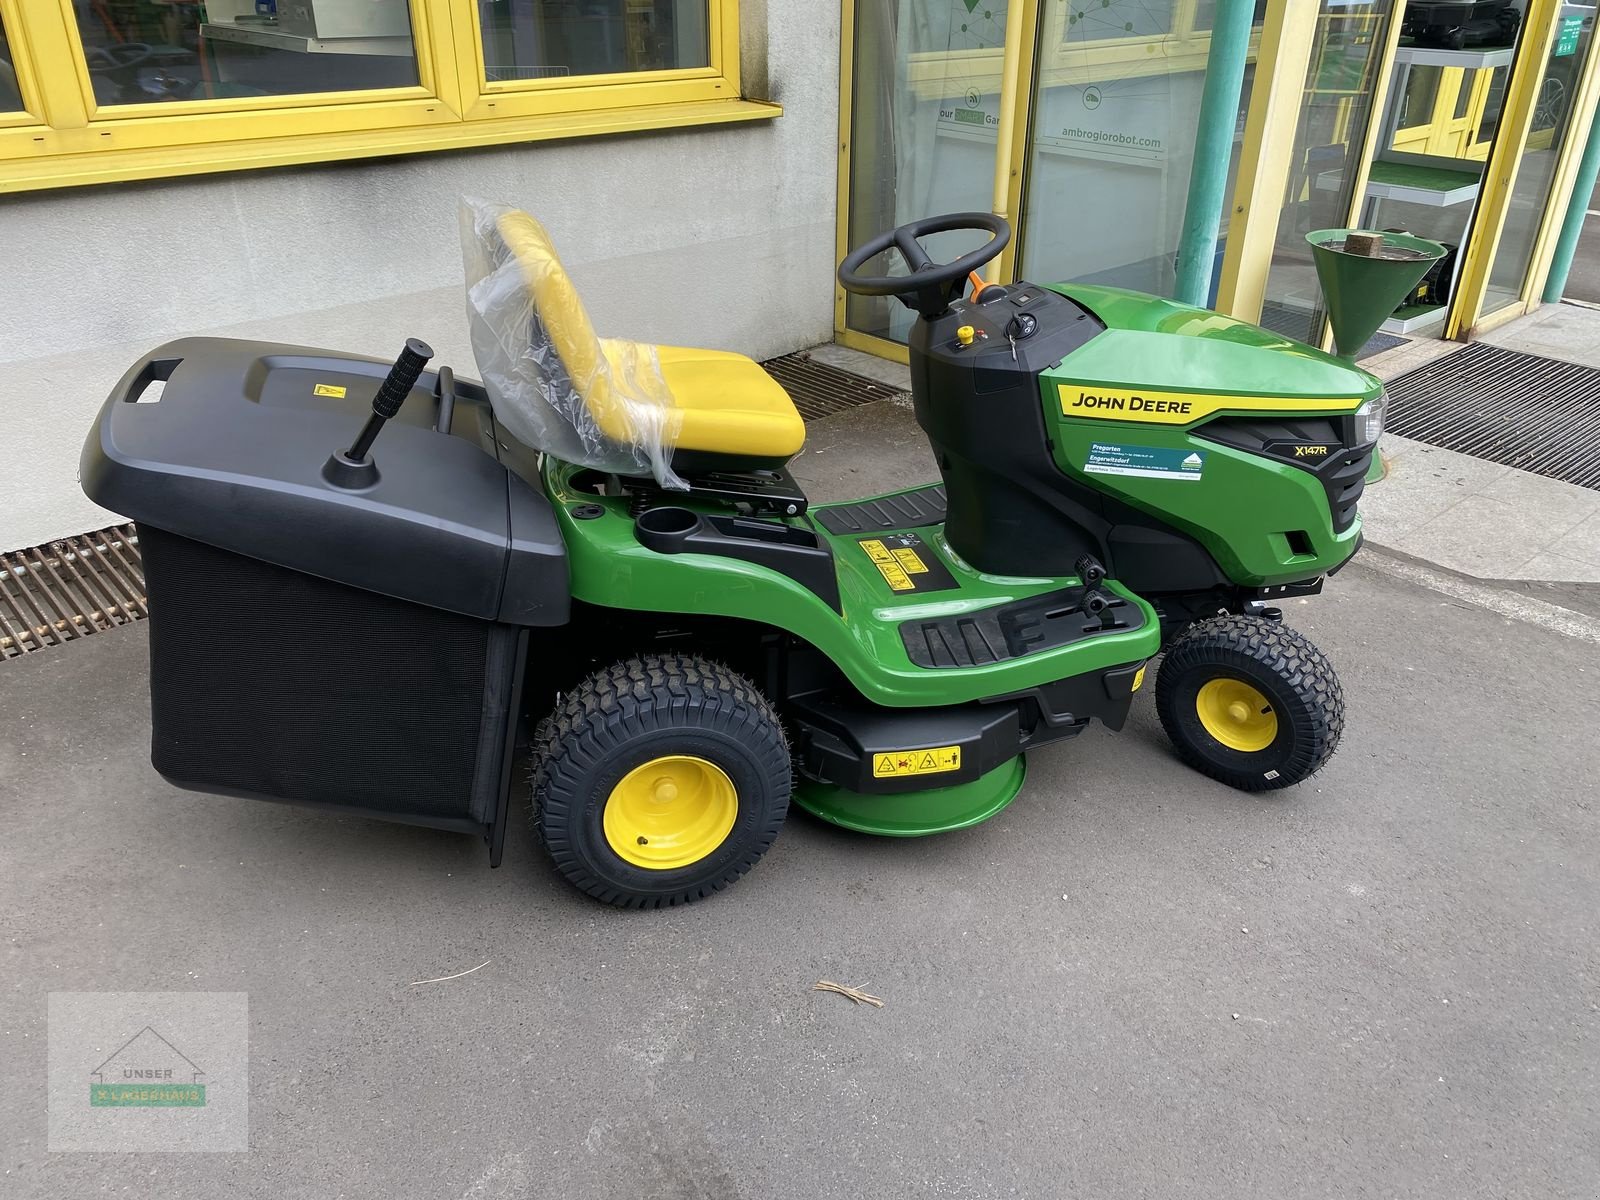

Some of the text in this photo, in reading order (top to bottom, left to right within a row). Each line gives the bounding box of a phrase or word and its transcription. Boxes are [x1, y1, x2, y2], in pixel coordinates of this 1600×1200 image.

[1062, 128, 1161, 148] ambrogiorobot.com
[1092, 444, 1121, 452] Pregarten
[1295, 446, 1328, 456] X147R
[1089, 455, 1130, 464] Engerwitzdorf
